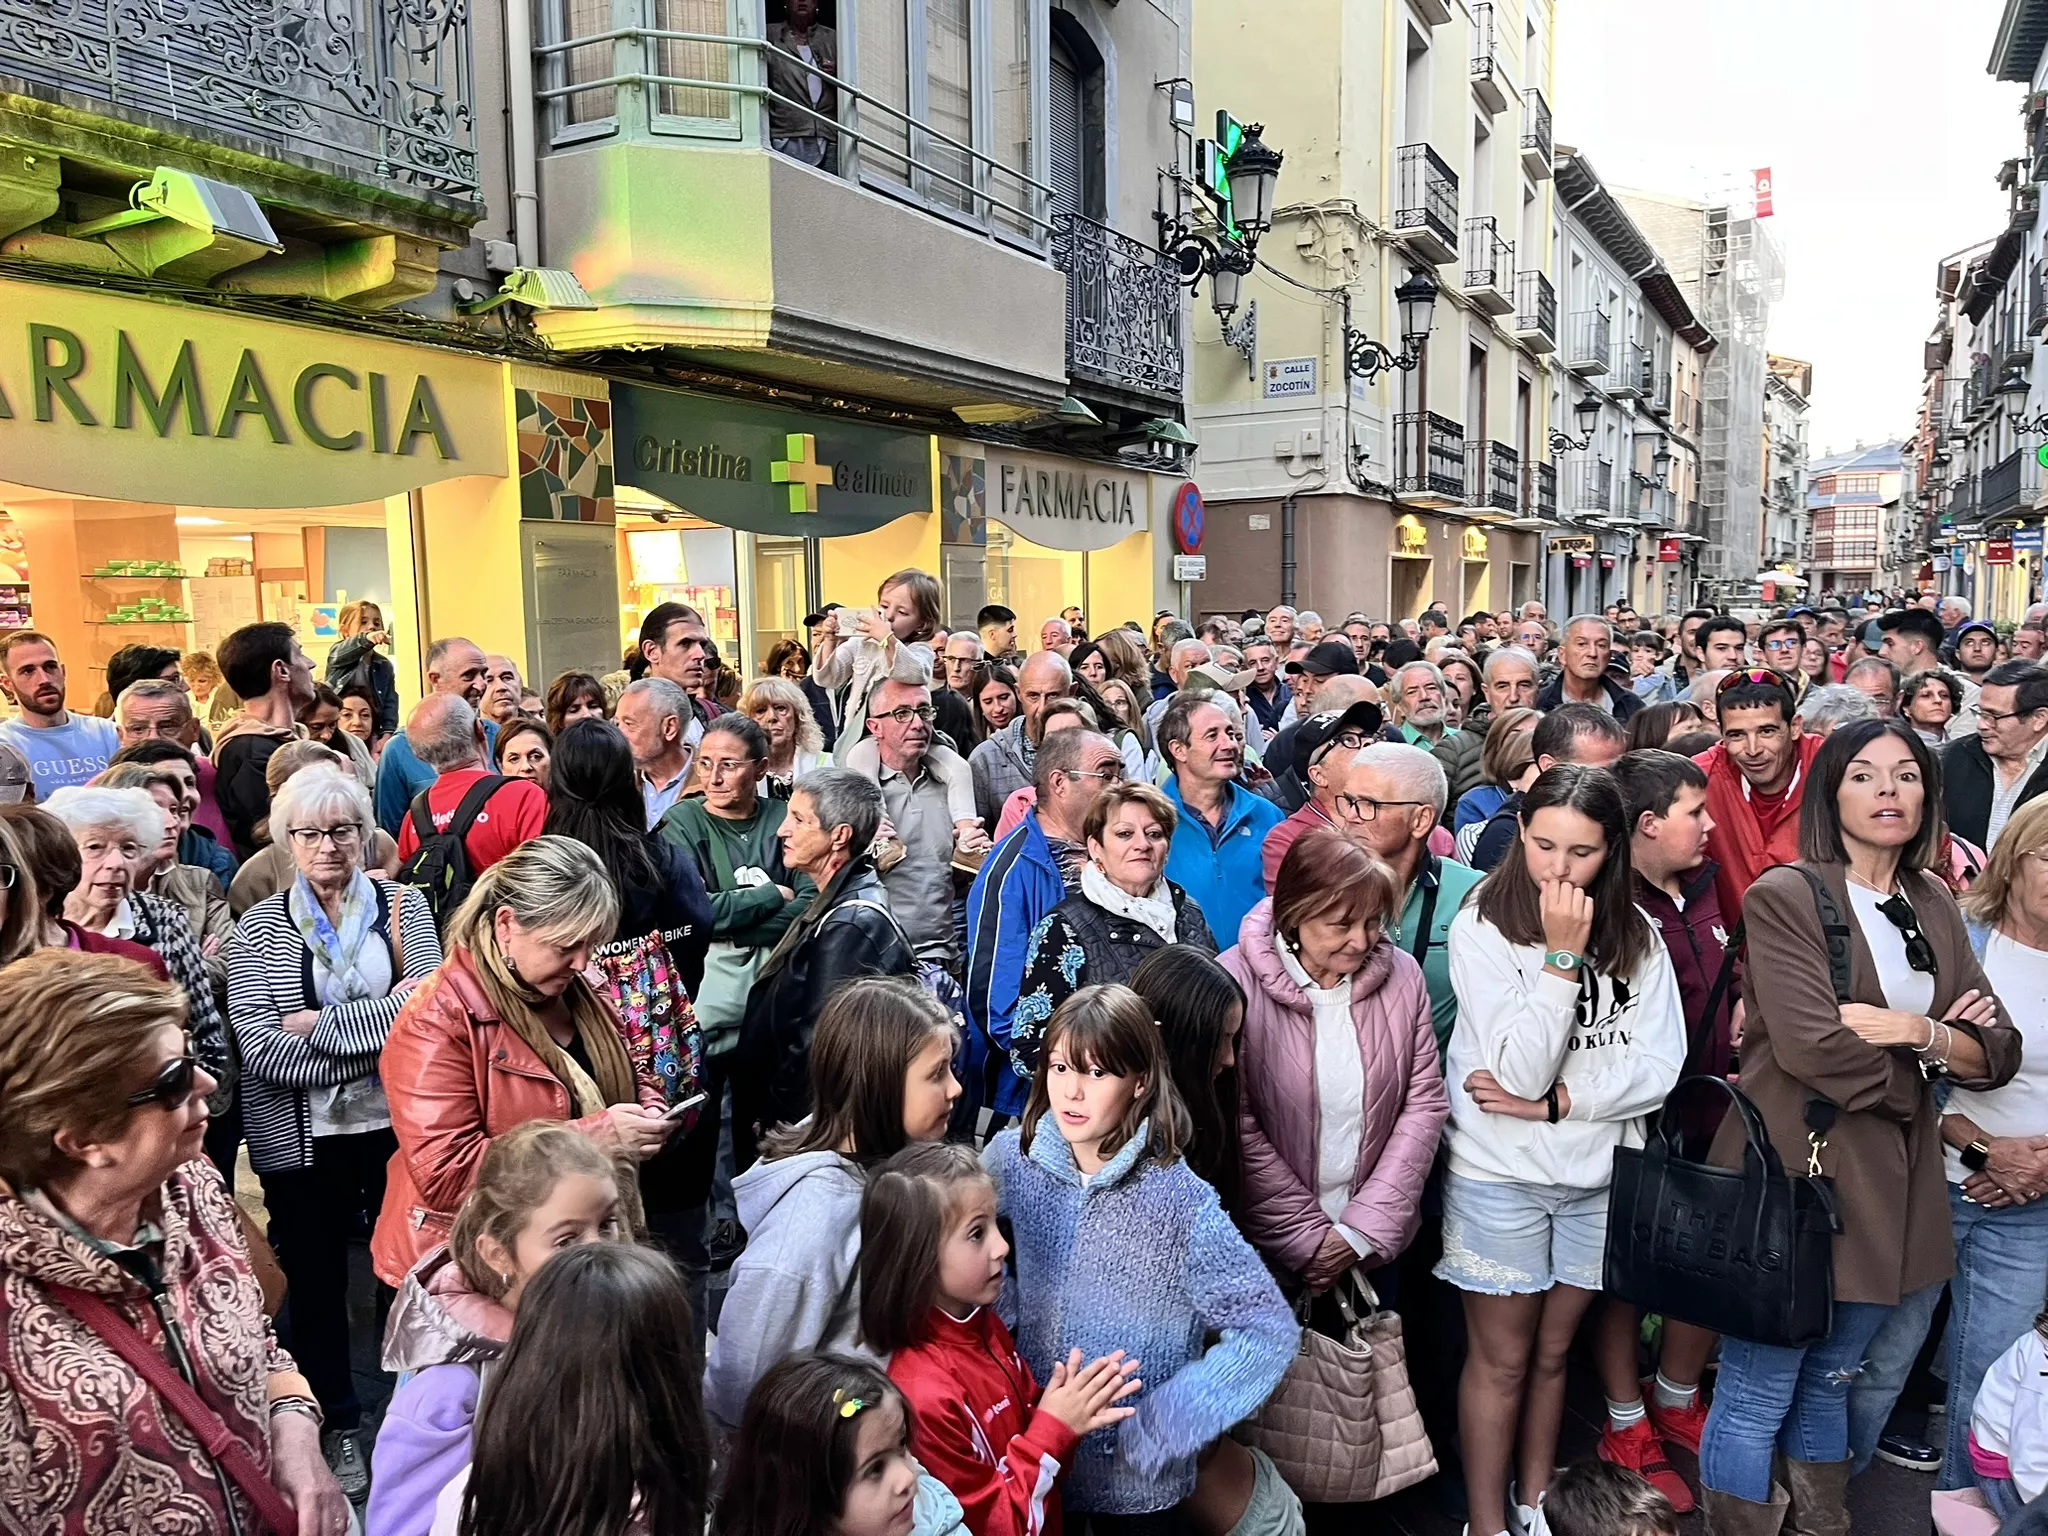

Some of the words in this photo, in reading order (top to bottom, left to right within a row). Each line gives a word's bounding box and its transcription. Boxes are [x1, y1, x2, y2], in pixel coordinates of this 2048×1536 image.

[1284, 364, 1310, 374] CALLE
[1269, 378, 1310, 392] ZOCOTÍN
[633, 434, 751, 482] Cristina
[834, 460, 917, 498] Galindo
[1001, 464, 1135, 526] FARMACIA
[33, 755, 109, 776] GUESS
[664, 924, 693, 943] BIKE
